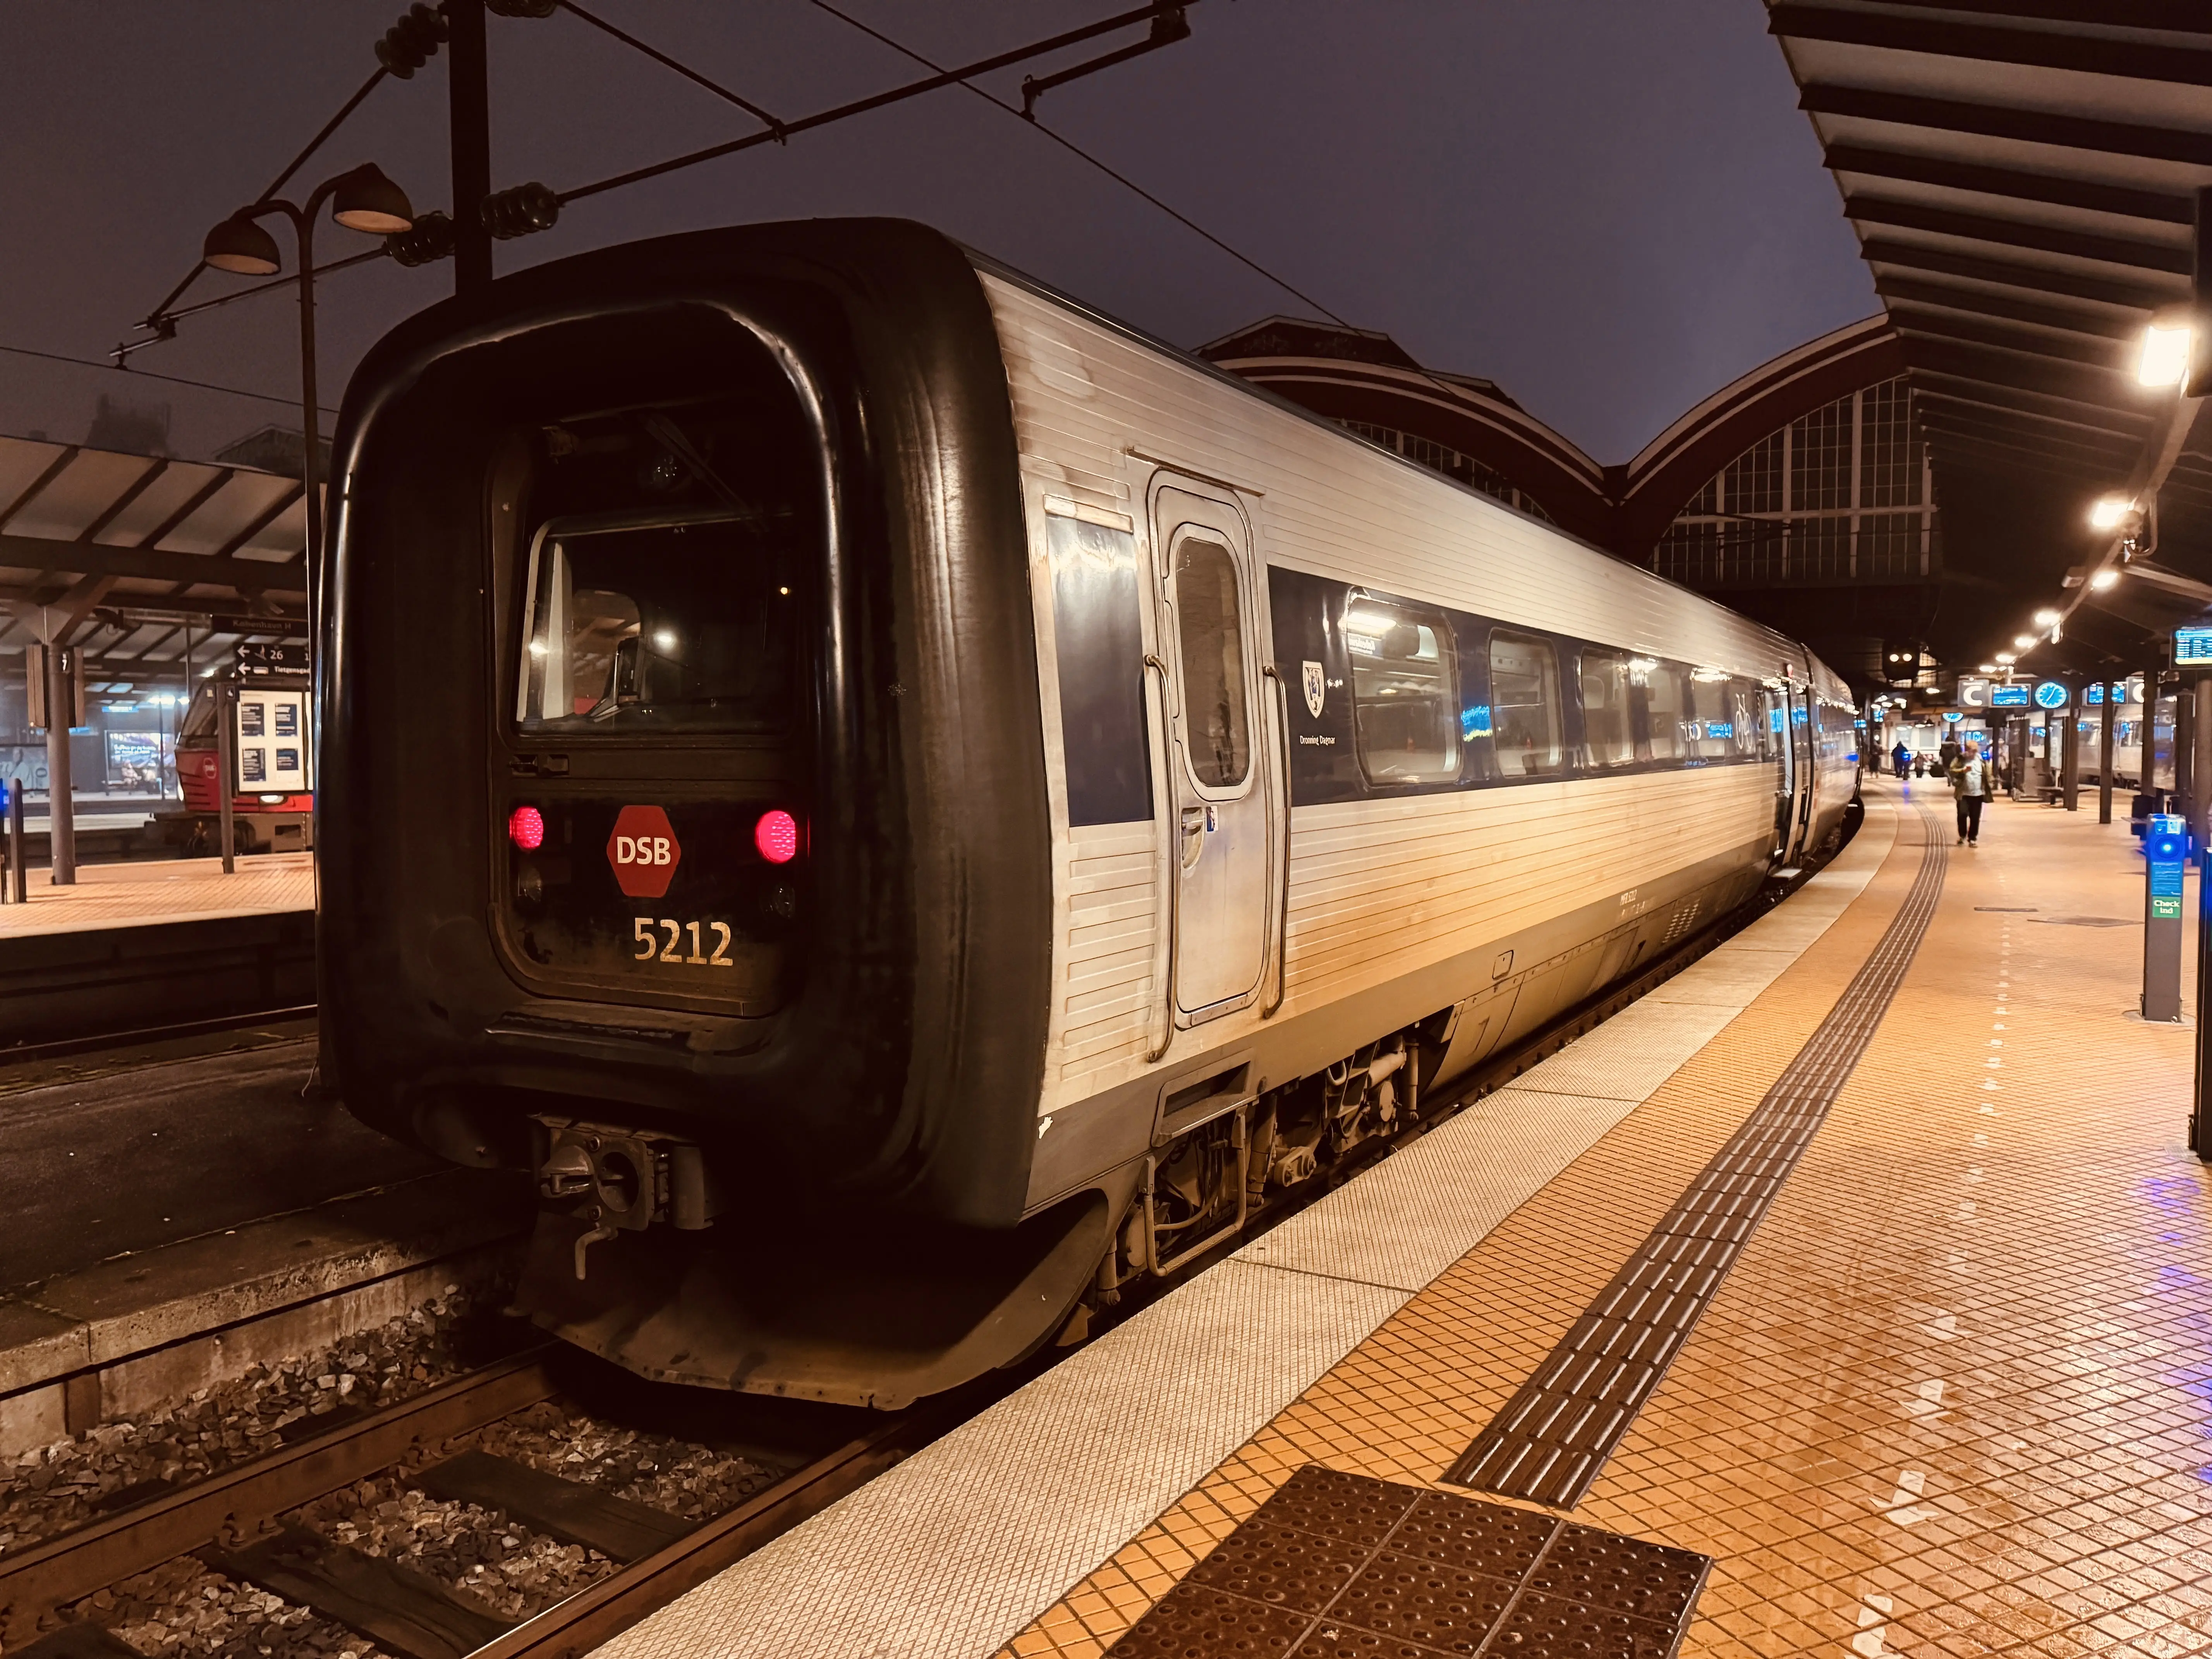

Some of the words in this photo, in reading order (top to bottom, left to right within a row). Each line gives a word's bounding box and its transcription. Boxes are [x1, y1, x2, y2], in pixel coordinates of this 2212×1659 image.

[270, 650, 283, 660] 26
[62, 659, 67, 671] 7
[275, 666, 310, 674] Tietgensgad
[1963, 685, 1982, 706] C
[1300, 735, 1319, 746] Dronning
[1319, 735, 1335, 746] Dagmar
[617, 836, 671, 865] DSB
[635, 917, 733, 966] 5212
